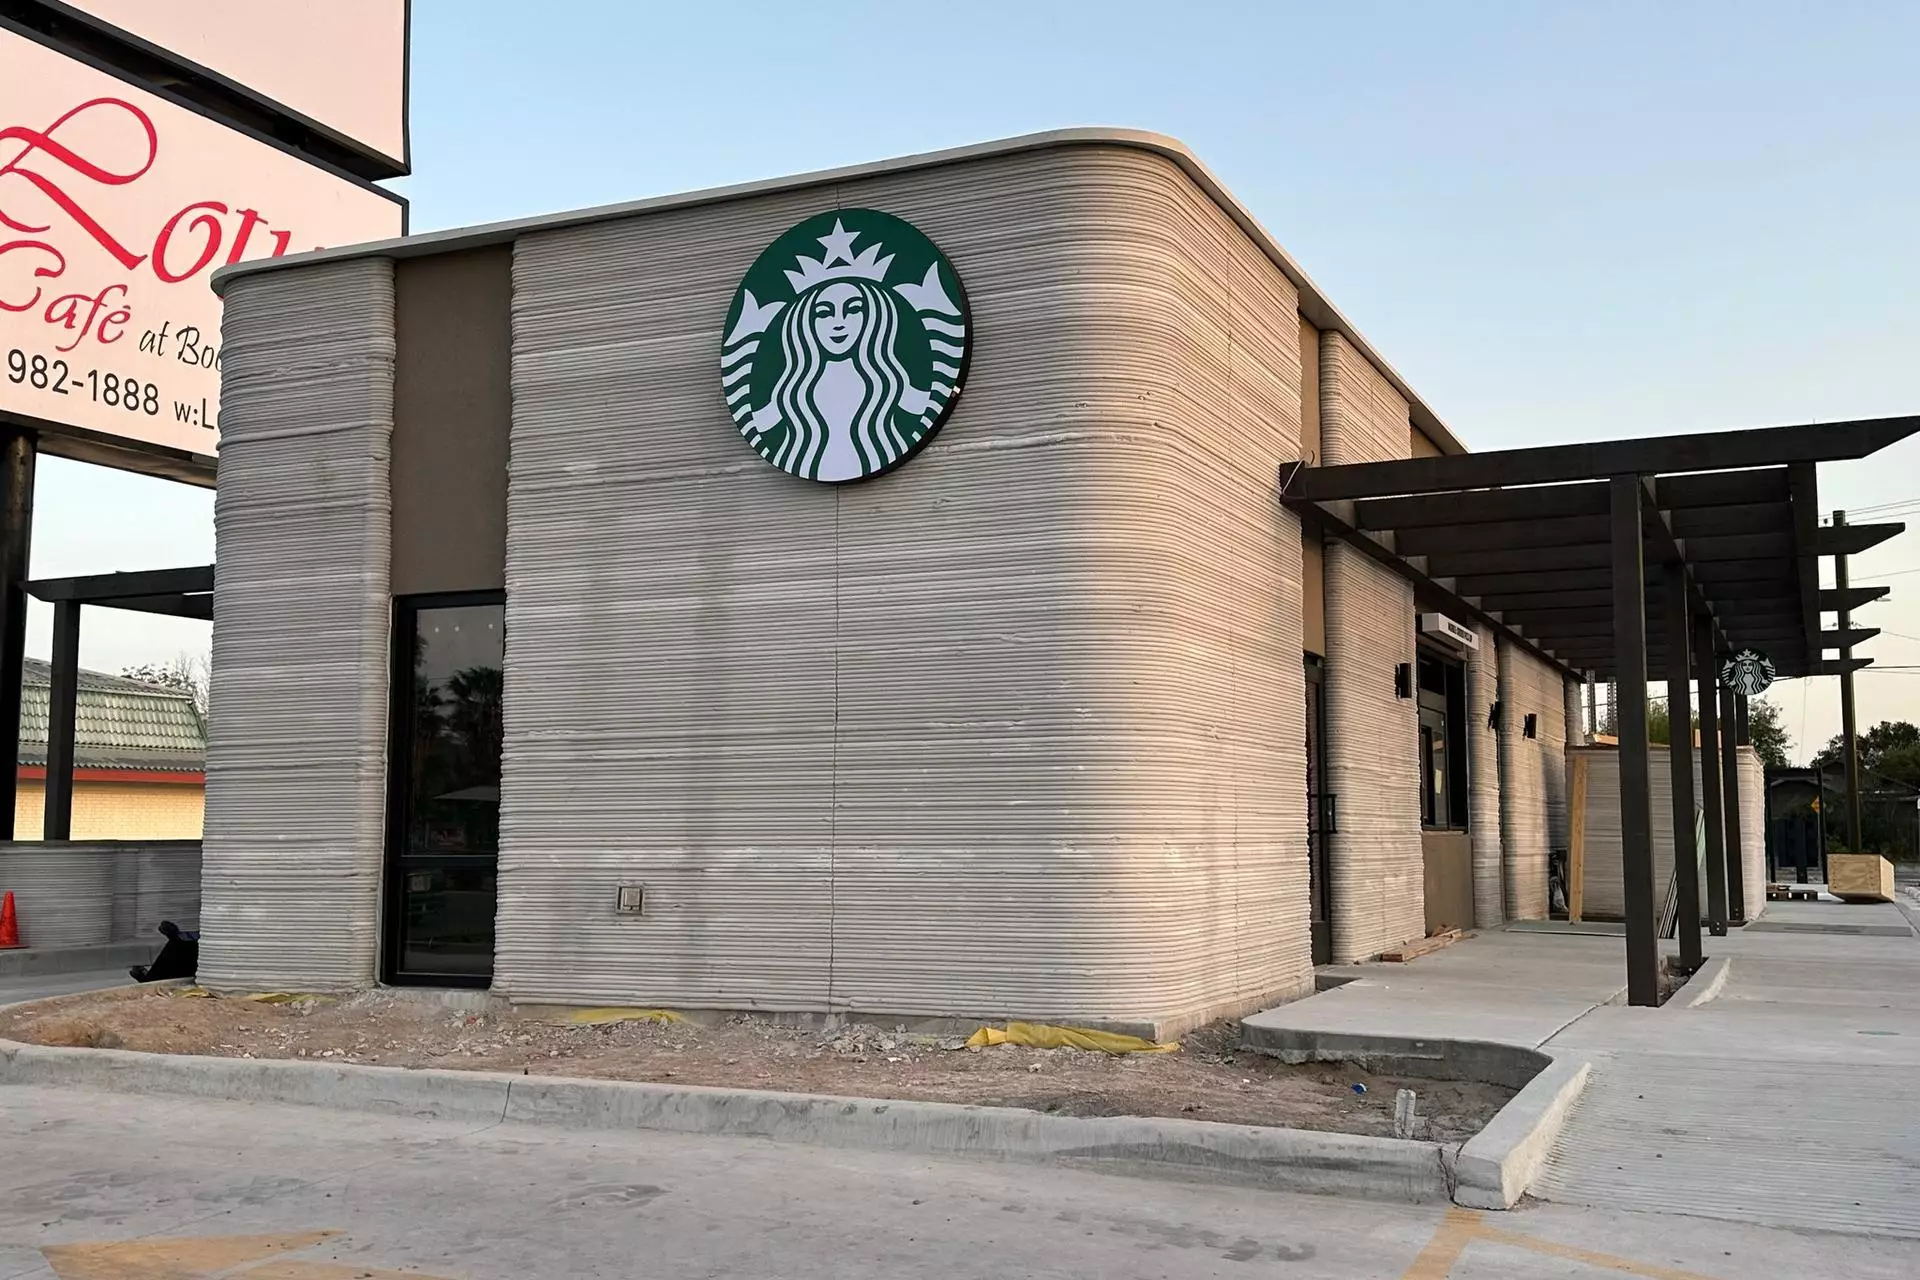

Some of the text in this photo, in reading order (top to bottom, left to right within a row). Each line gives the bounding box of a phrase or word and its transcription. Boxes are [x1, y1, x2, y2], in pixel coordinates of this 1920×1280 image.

[139, 321, 170, 357] at
[7, 348, 221, 433] 982-1888 w:L
